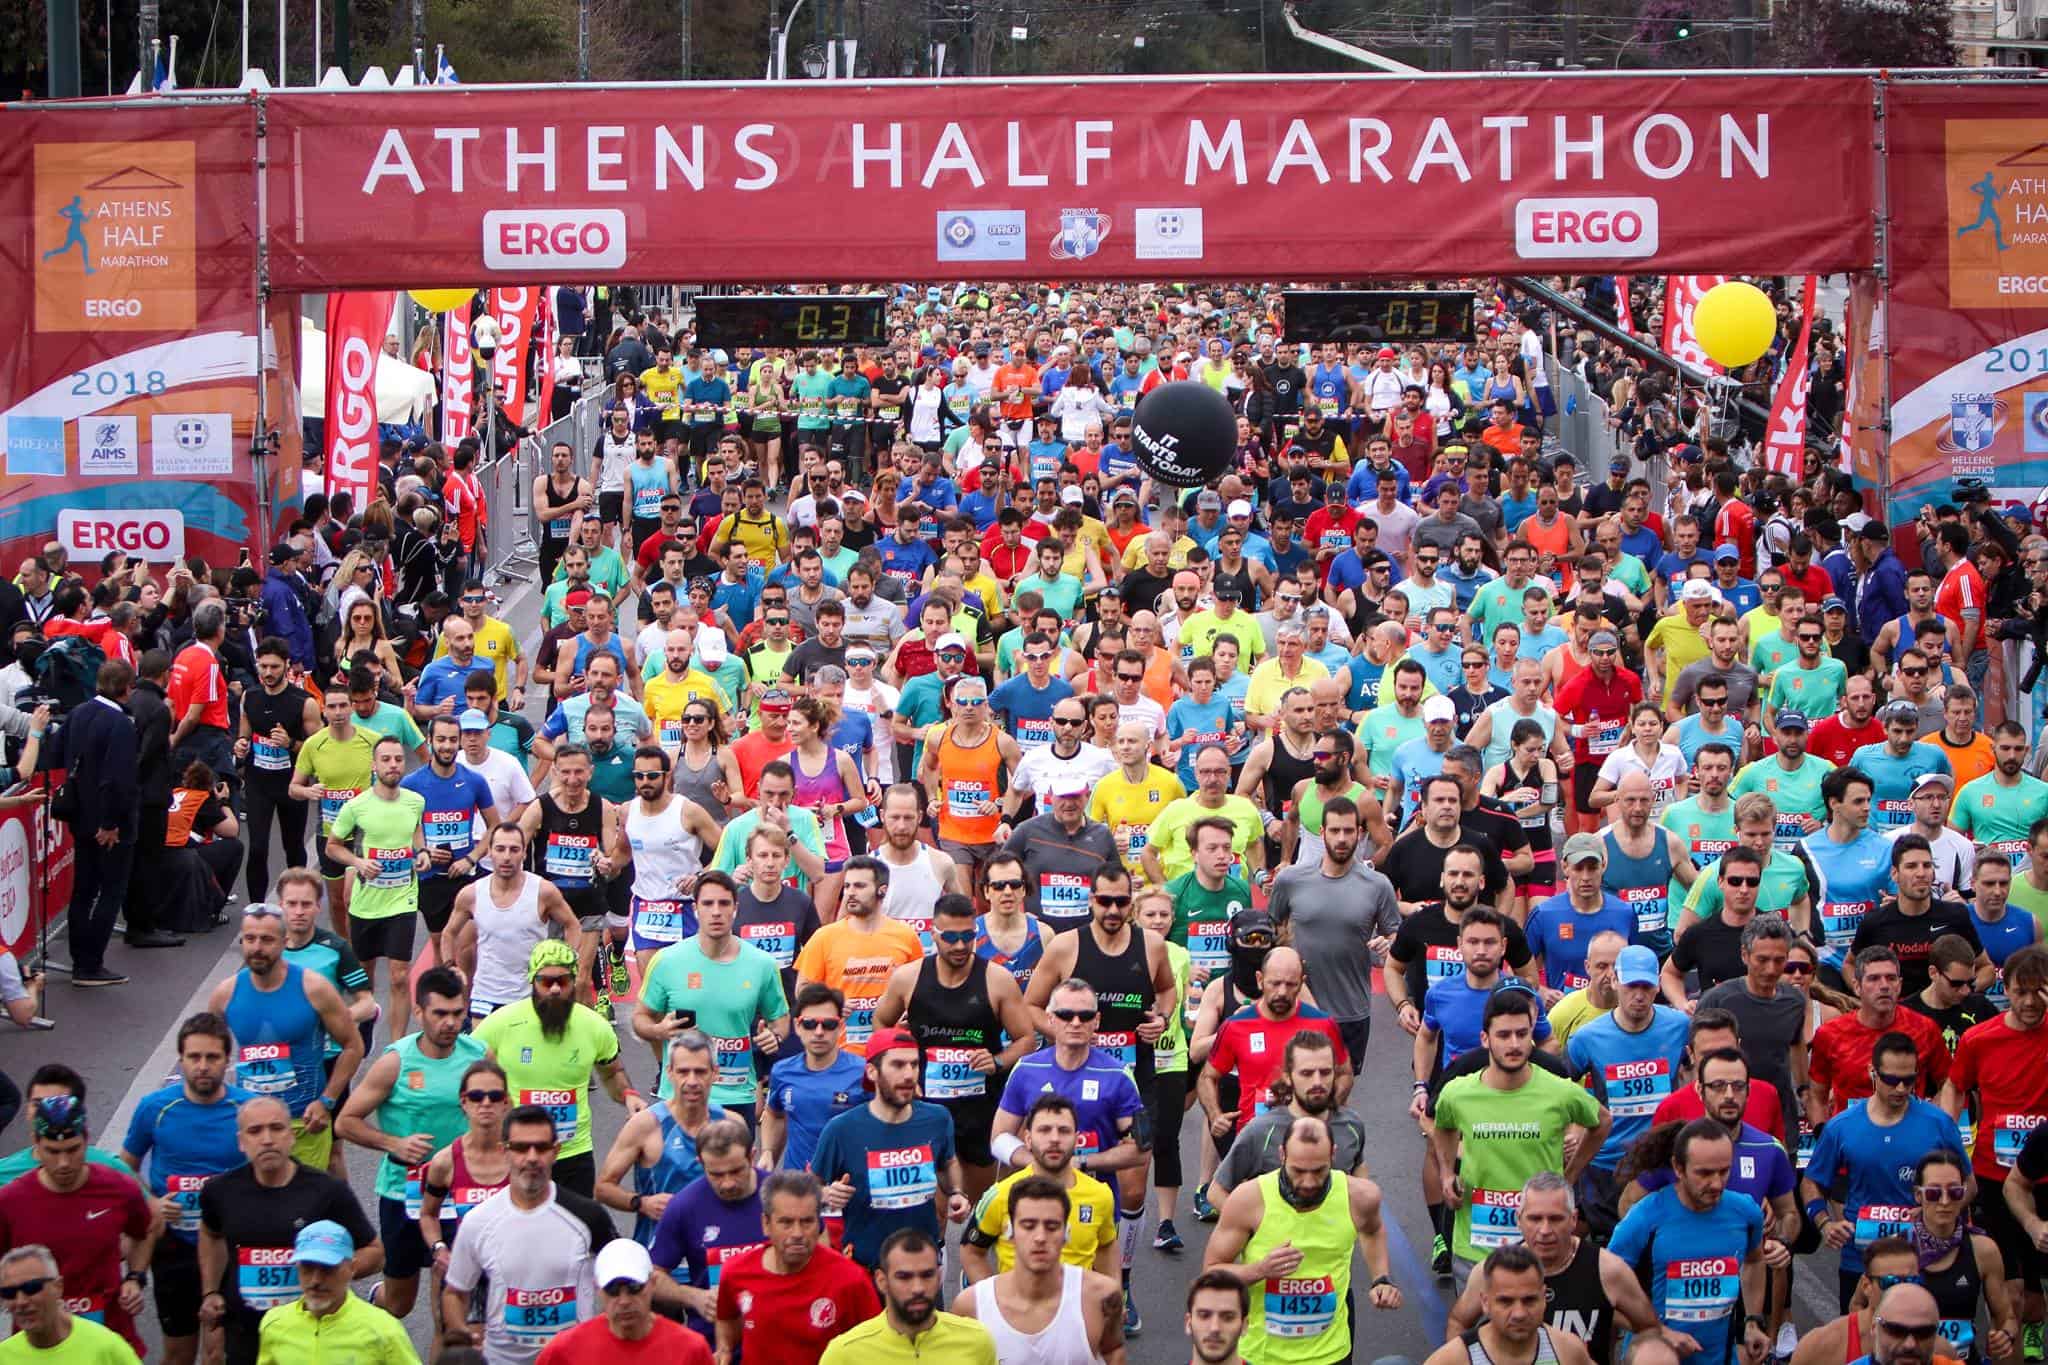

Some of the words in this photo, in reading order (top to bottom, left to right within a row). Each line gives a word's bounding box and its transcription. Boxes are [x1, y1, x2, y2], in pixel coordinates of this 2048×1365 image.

[362, 123, 780, 195] ATHENS
[852, 120, 1114, 189] HALF
[1184, 113, 1769, 185] MARATHON
[2008, 178, 2048, 195] ATH
[97, 201, 173, 218] ATHENS
[2015, 203, 2048, 225] HA
[1531, 209, 1643, 244] ERGO
[103, 225, 164, 247] HALF
[499, 221, 611, 256] ERGO
[2012, 232, 2048, 244] MARA
[100, 255, 169, 267] MARATHON
[85, 298, 143, 318] ERGO
[1984, 348, 2048, 373] 201
[71, 370, 167, 396] 2018
[1951, 392, 1995, 402] SEGAS
[1133, 424, 1177, 462] STARTS
[1159, 433, 1180, 449] IT
[91, 448, 127, 459] AIMS
[1951, 456, 1995, 465] HELLENIC
[1151, 455, 1203, 477] TODAY
[1951, 466, 1995, 474] ATHLETICS
[72, 520, 170, 550] ERGO
[1360, 682, 1381, 697] AS
[1024, 719, 1052, 730] ERGO
[1025, 730, 1049, 742] 1278
[953, 781, 982, 791] ERGO
[327, 789, 355, 800] ERGO
[432, 811, 463, 822] ERGO
[1888, 812, 1912, 825] 1127
[437, 823, 459, 836] 599
[558, 835, 590, 847] ERGO
[376, 849, 407, 859] ERGO
[557, 847, 586, 860] 1233
[1049, 875, 1082, 886] ERGO
[1052, 886, 1081, 900] 1445
[1627, 888, 1660, 900] ERGO
[647, 902, 675, 913] ERGO
[1833, 903, 1866, 915] ERGO
[646, 913, 673, 927] 1232
[750, 925, 785, 936] ERGO
[1437, 949, 1463, 960] ERG
[1097, 1033, 1128, 1046] RGO
[245, 1045, 279, 1059] ERGO
[941, 1063, 970, 1080] 897
[1617, 1062, 1657, 1078] ERGO
[1623, 1078, 1655, 1096] 598
[530, 1091, 571, 1104] ERGO
[1472, 1122, 1541, 1131] HERBALIFE
[1473, 1130, 1541, 1139] NUTRITION
[879, 1150, 922, 1167] ERGO
[886, 1167, 922, 1187] 1102
[1680, 1261, 1726, 1276] ERGO
[257, 1267, 290, 1287] 857
[1278, 1279, 1326, 1294] ERGO
[1683, 1279, 1722, 1298] 1018
[516, 1288, 564, 1305] ERGO
[1280, 1296, 1323, 1315] 1452
[523, 1306, 560, 1326] 854
